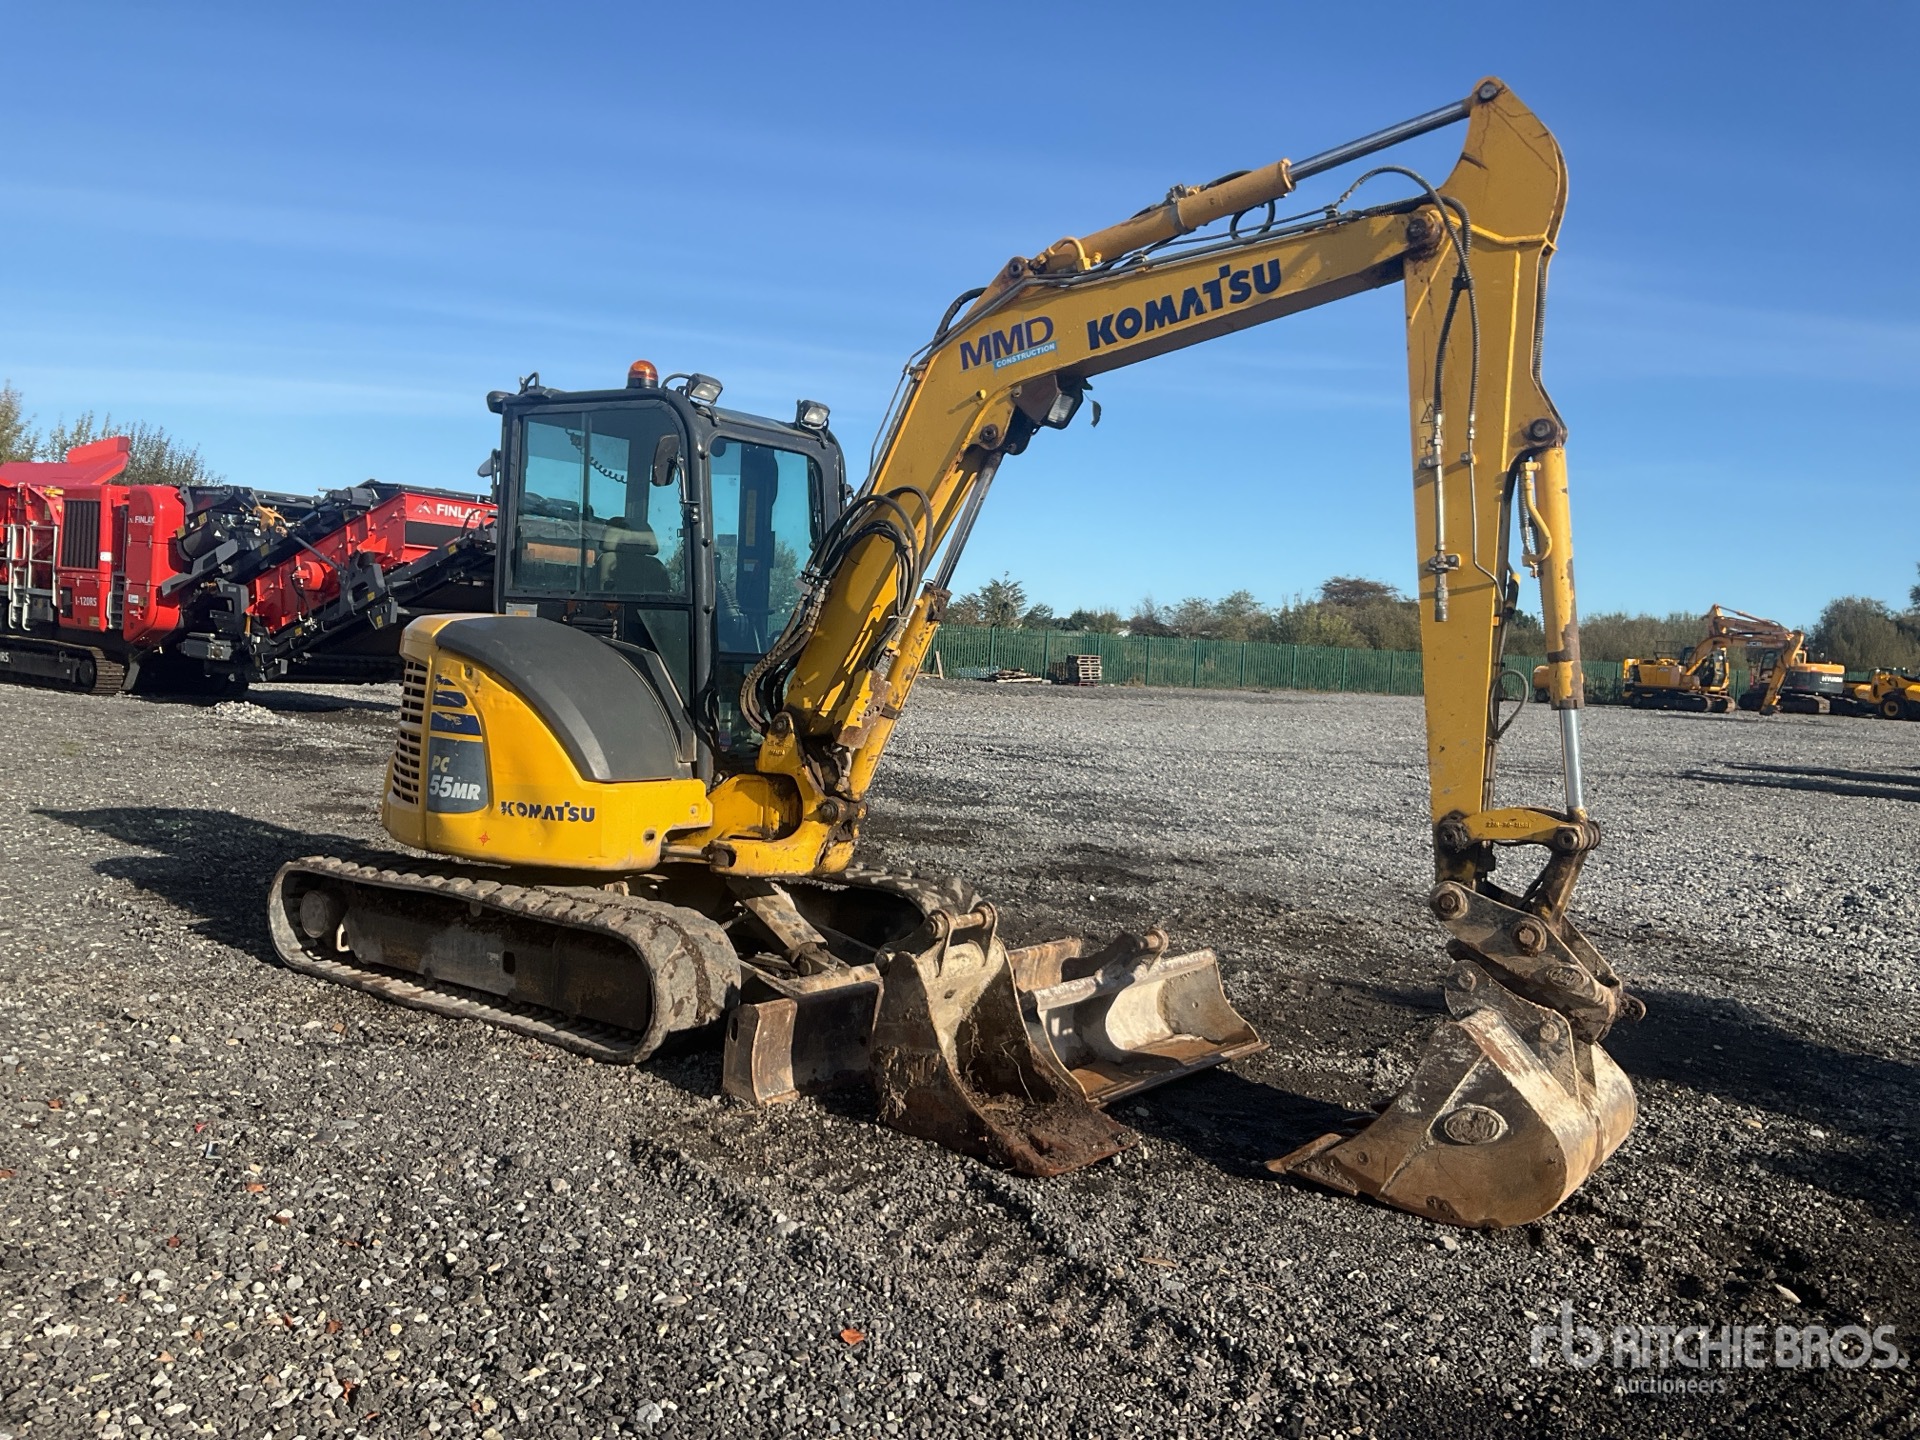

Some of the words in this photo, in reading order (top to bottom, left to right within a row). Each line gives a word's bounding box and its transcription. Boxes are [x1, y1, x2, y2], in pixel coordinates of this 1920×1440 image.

[1086, 258, 1282, 350] KOMATSU
[960, 316, 1054, 370] MMD
[996, 344, 1056, 368] CONSTRUCTION
[134, 515, 155, 524] FINLAY
[436, 503, 481, 520] FINLAY
[431, 755, 451, 773] PC
[429, 774, 481, 801] 55MR
[501, 801, 595, 822] KOMATSU
